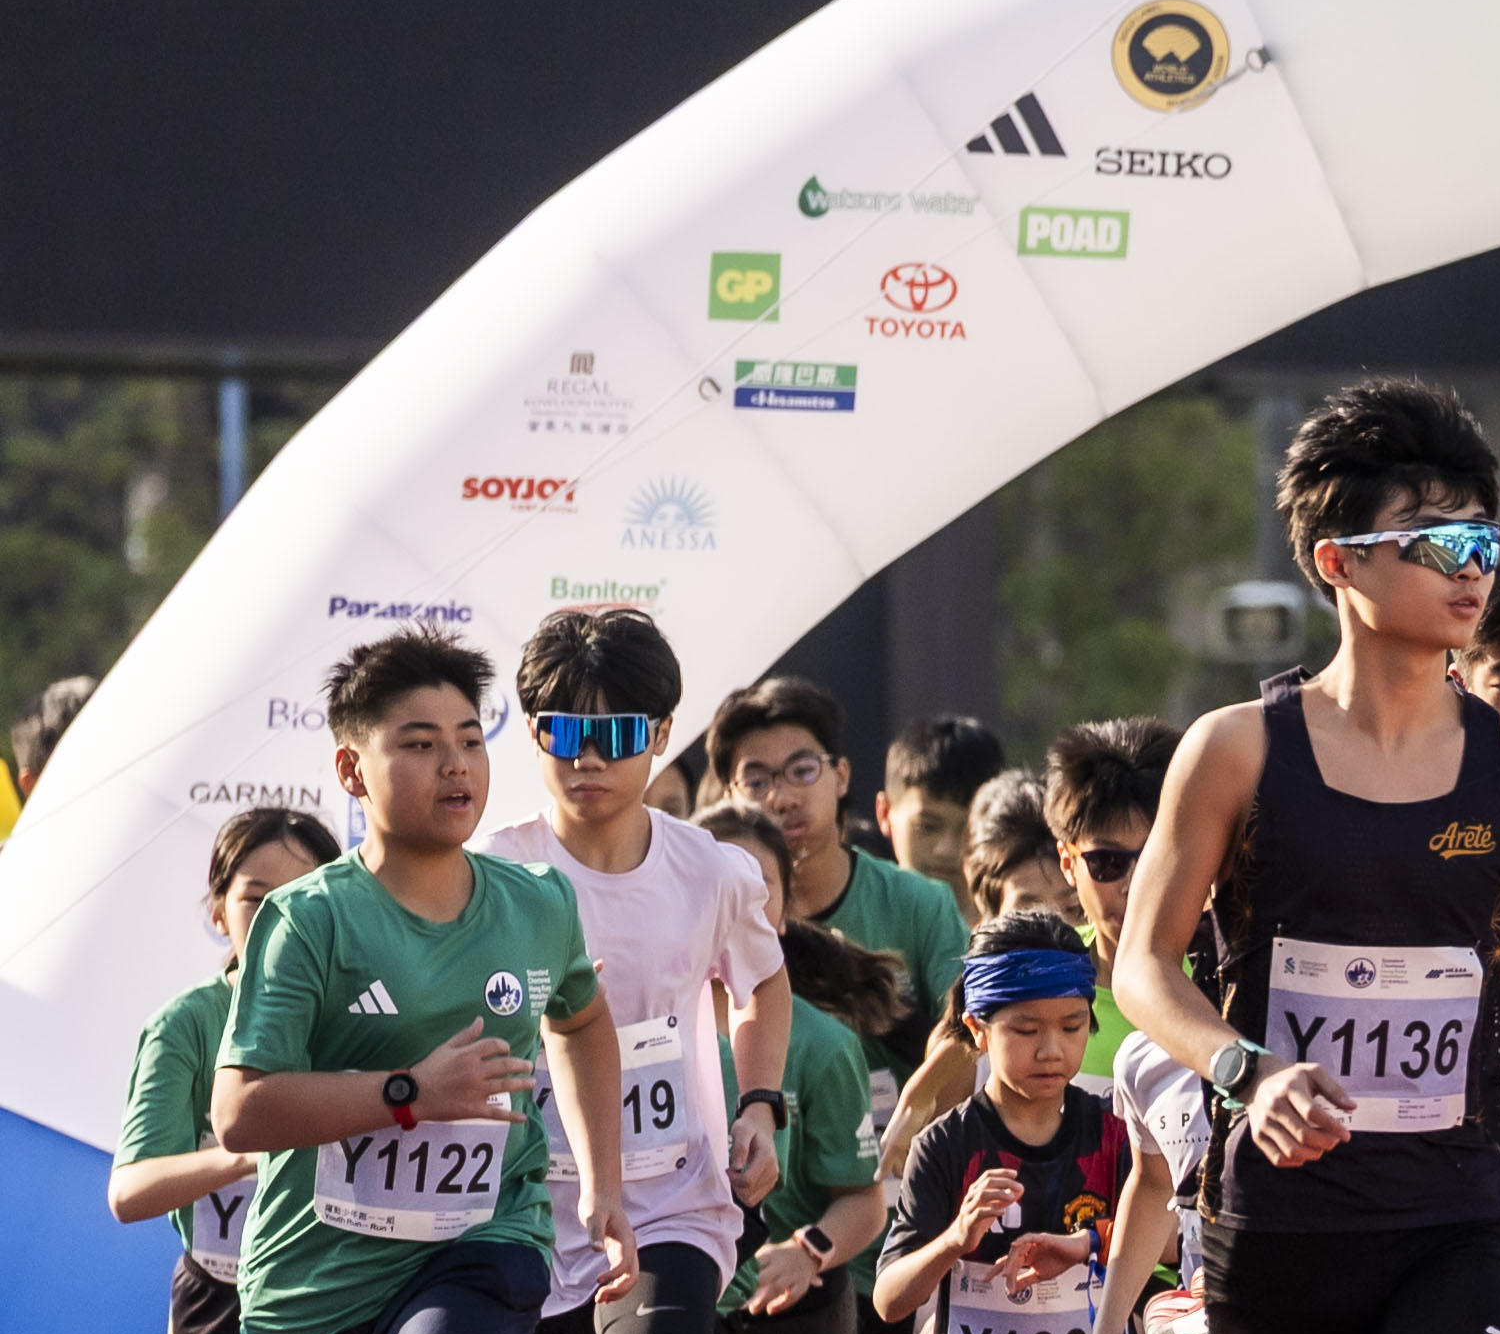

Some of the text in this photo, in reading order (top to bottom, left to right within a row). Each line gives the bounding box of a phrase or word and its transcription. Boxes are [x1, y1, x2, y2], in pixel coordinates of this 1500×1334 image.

[1095, 147, 1232, 180] SEIKO
[1026, 214, 1121, 253] POAD
[716, 269, 773, 304] GP
[865, 316, 967, 341] TOYOTA
[546, 378, 614, 397] REGAL
[461, 476, 578, 503] SOYJOY
[620, 526, 717, 552] ANESSA
[550, 576, 660, 601] Banitore
[328, 595, 473, 624] Panasonic
[189, 780, 322, 807] GARMIN
[1284, 1010, 1463, 1080] Y1136
[338, 1136, 495, 1195] Y1122
[324, 1212, 345, 1226] Youth
[370, 1222, 387, 1233] Run
[390, 1223, 396, 1233] 1
